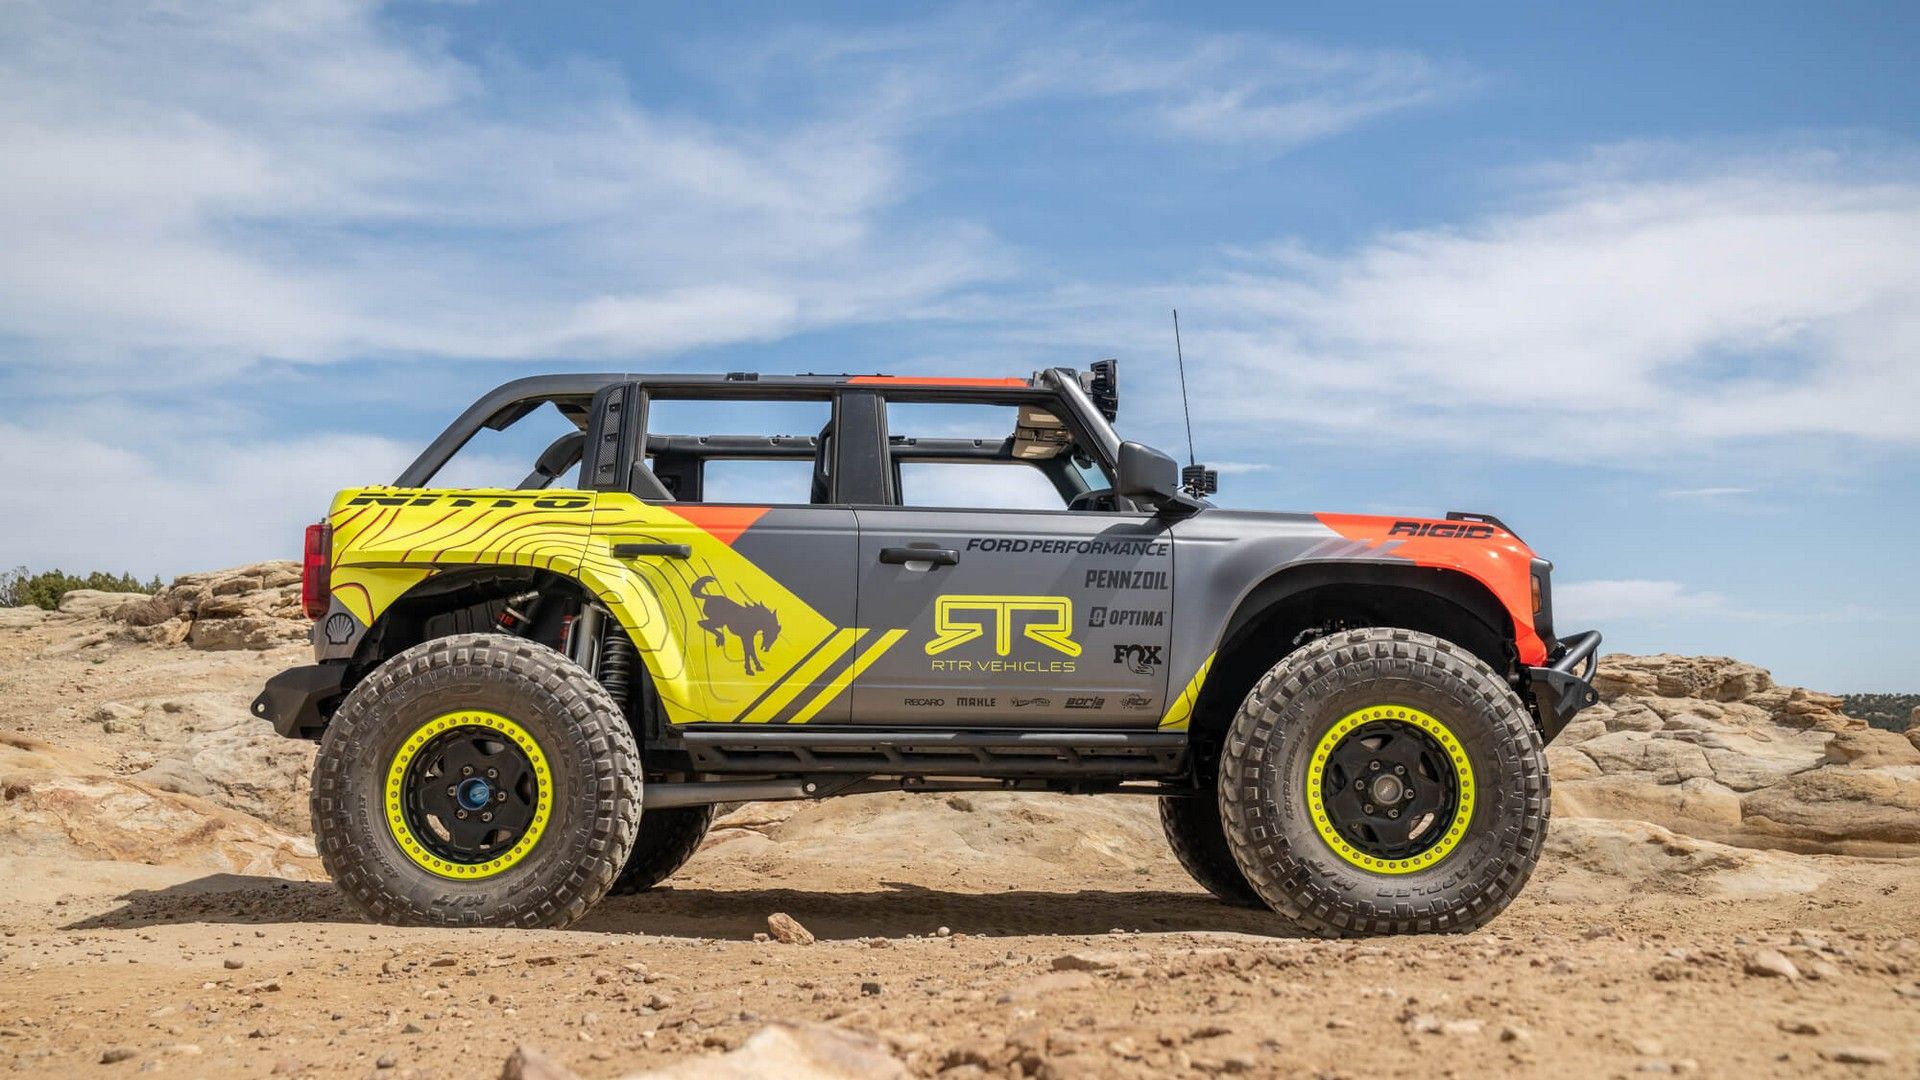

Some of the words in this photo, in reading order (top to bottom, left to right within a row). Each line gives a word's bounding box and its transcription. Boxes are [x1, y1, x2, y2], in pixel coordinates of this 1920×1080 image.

[346, 493, 590, 508] NITTO
[1389, 521, 1494, 539] RIGID
[966, 538, 1035, 553] FORD
[1031, 540, 1169, 556] PERFORMANCE
[1085, 569, 1169, 590] PENNZOIL
[925, 594, 1082, 657] RTR
[1109, 609, 1163, 627] OPTIMA
[1113, 644, 1162, 668] FOX
[931, 660, 974, 672] RTR
[978, 660, 1076, 673] VEHICLES
[904, 698, 945, 706] RECARO
[957, 697, 996, 707] MAHLE
